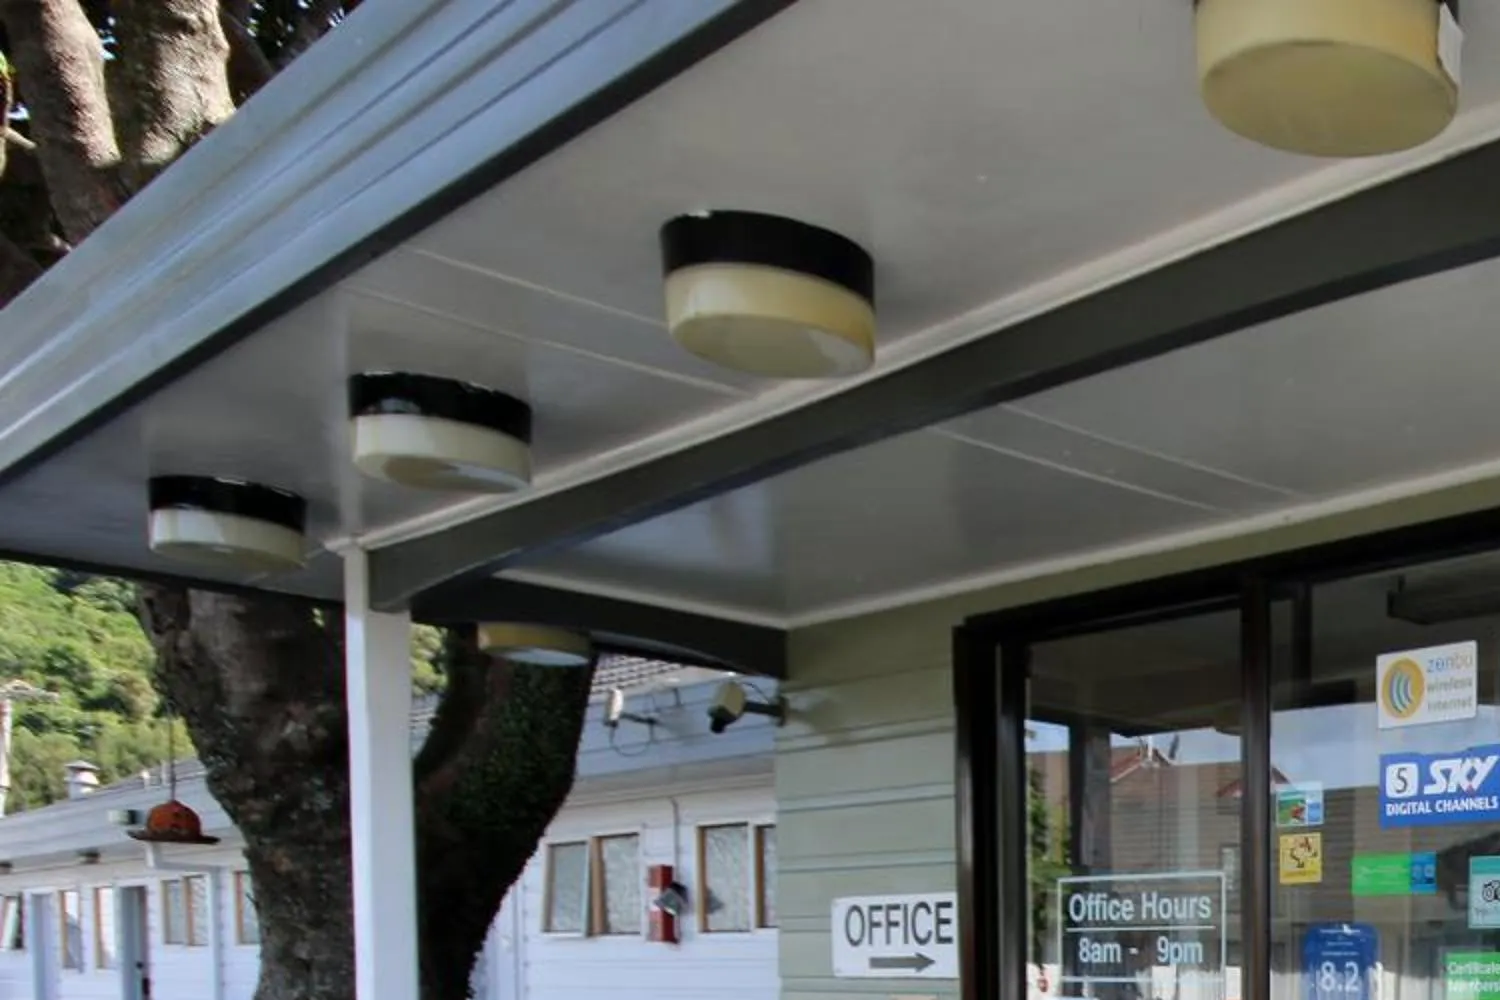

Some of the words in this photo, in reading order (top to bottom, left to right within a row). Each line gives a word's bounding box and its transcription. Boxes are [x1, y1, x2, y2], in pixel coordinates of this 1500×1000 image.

[1424, 755, 1499, 794] SKY
[1386, 802, 1432, 816] DIGITAL
[1435, 796, 1499, 812] CHANNELS
[1069, 894, 1134, 921] Office
[1141, 894, 1212, 919] Hours
[845, 901, 953, 946] OFFICE
[1078, 938, 1121, 963] 8am
[1157, 937, 1204, 967] 9pm
[1320, 960, 1360, 992] 8.2
[1448, 961, 1500, 975] Certificate
